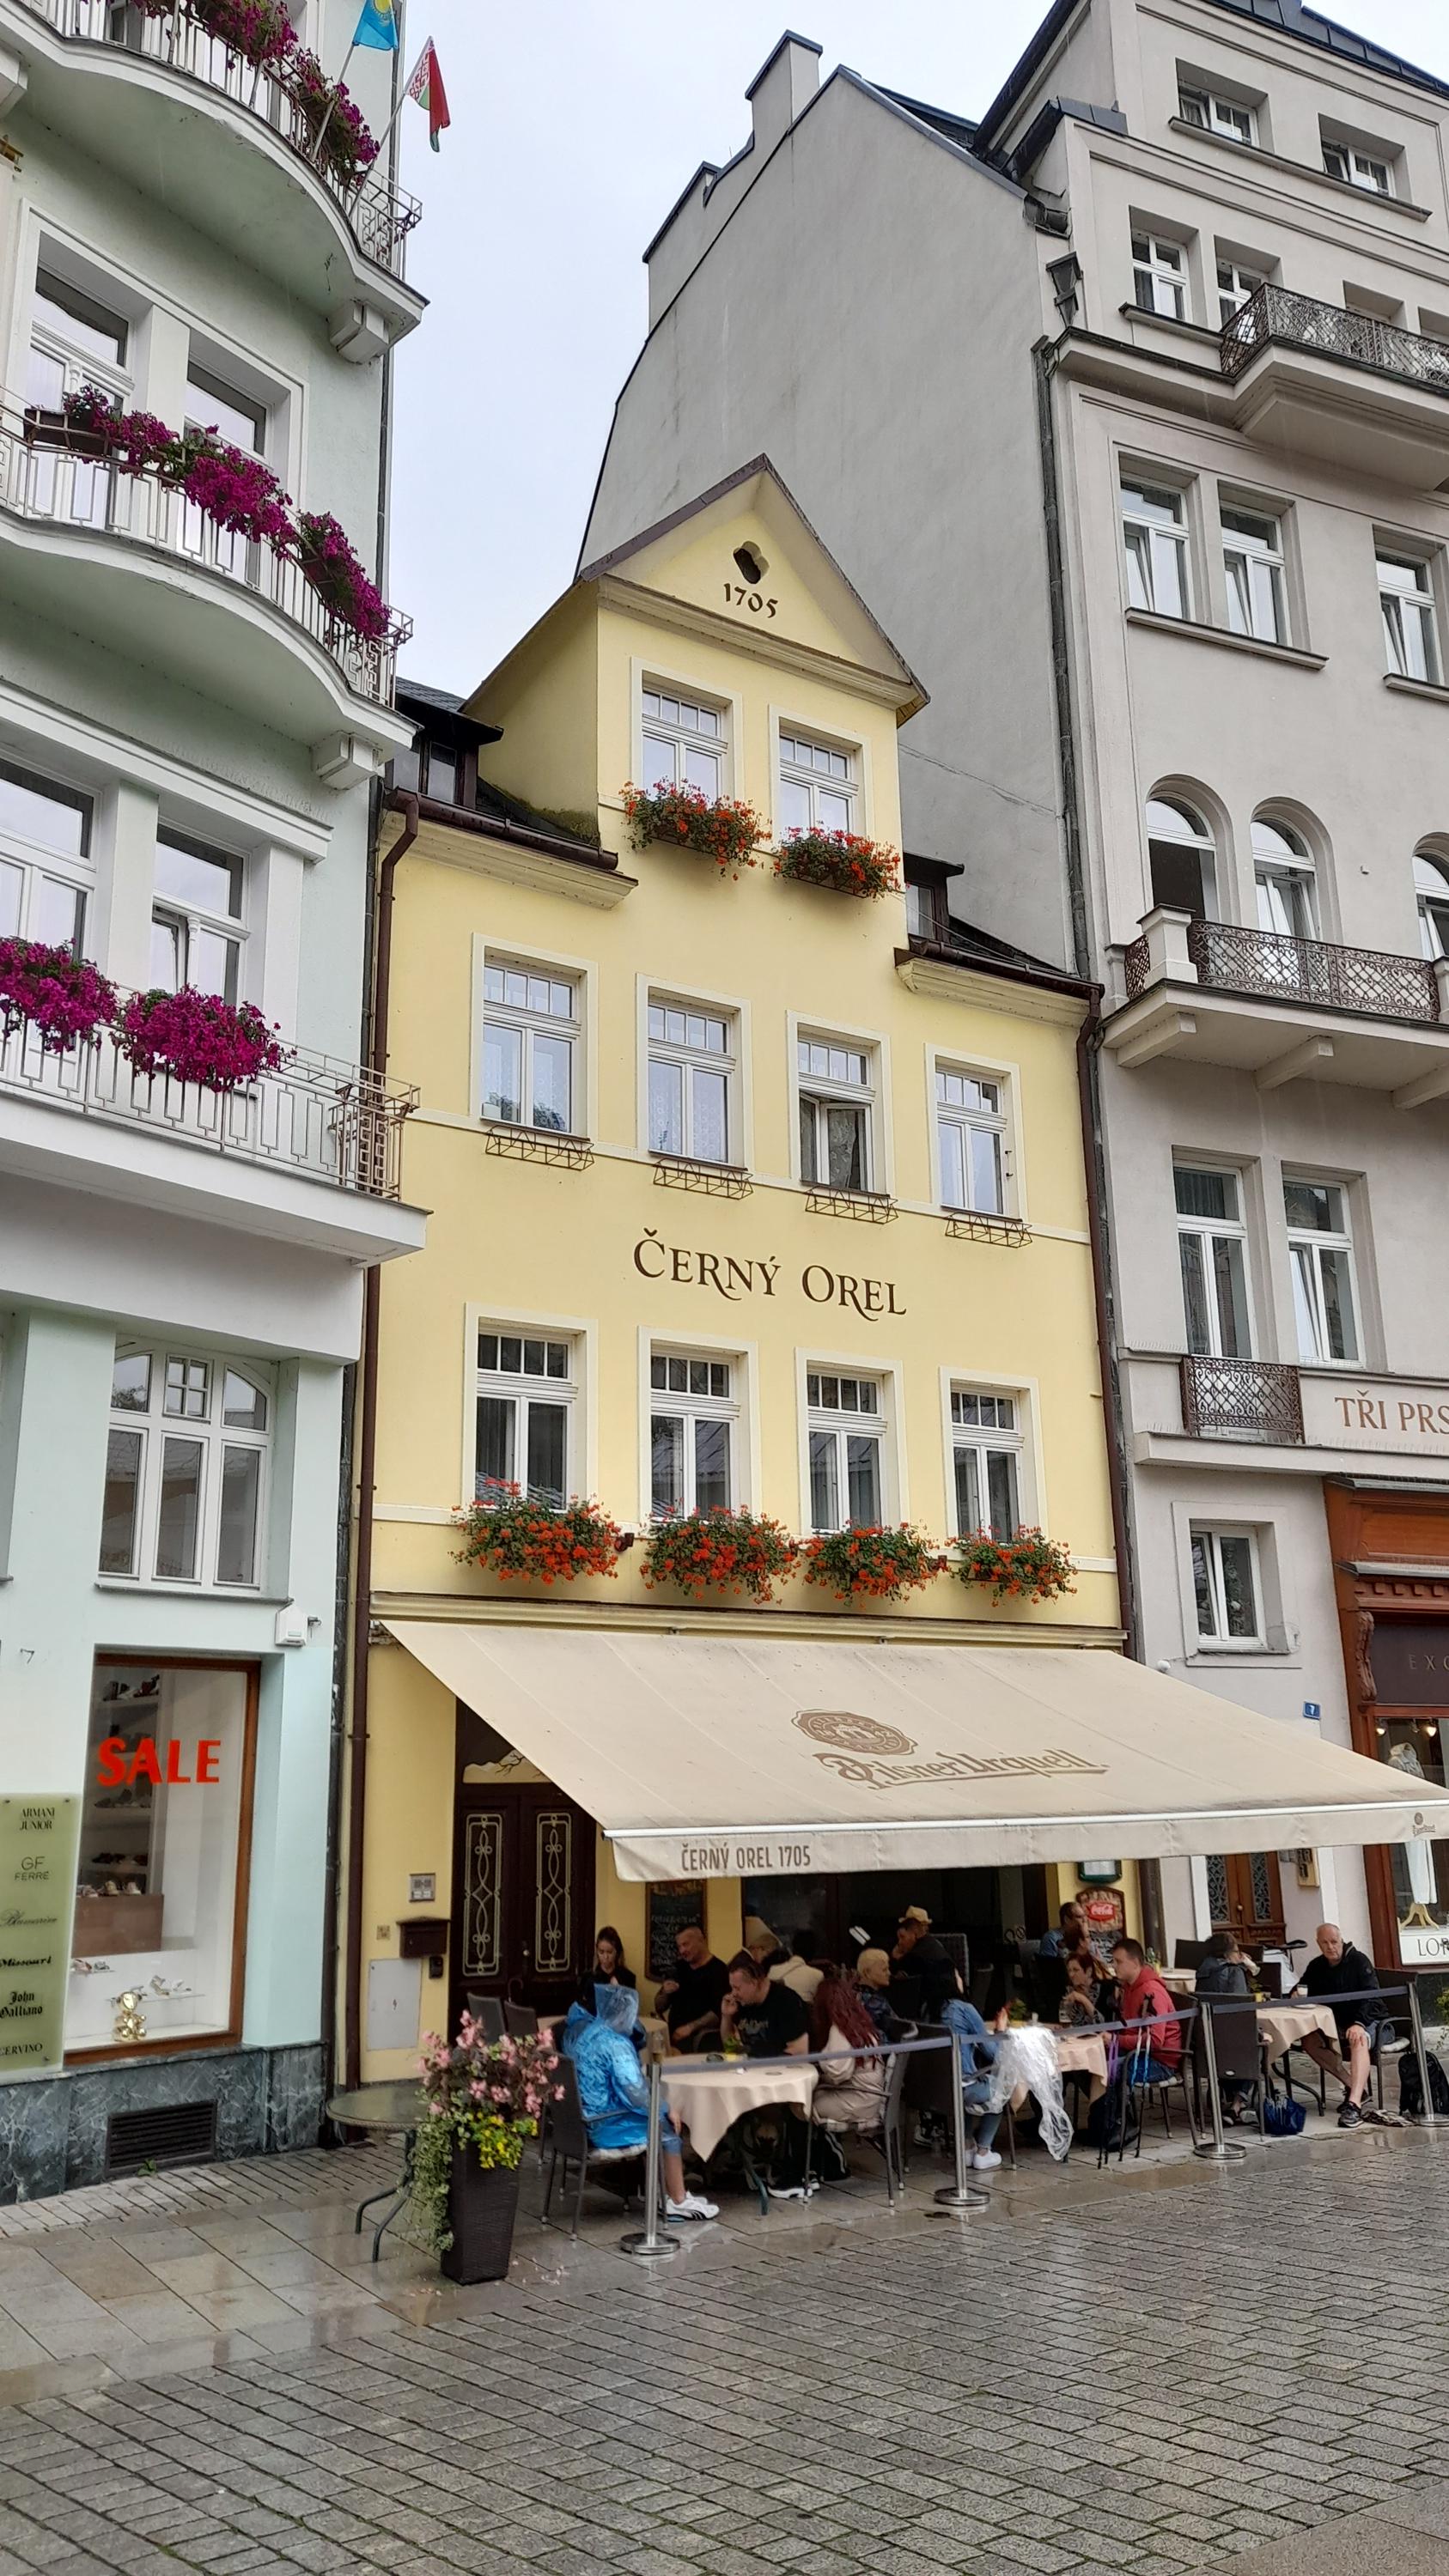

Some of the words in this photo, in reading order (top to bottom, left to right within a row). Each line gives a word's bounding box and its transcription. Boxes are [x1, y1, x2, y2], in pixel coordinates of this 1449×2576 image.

[723, 583, 778, 618] 1705
[634, 1227, 782, 1301] ČERNÝ
[801, 1265, 907, 1321] OREL
[1335, 1389, 1387, 1430] TŘI
[97, 1736, 221, 1787] SALE
[813, 1753, 967, 1789] Pilsner
[20, 1820, 53, 1831] JUNIOR
[21, 1807, 55, 1818] ARMANI
[21, 1856, 46, 1871] GF
[681, 1842, 729, 1871] ČERNÝ
[736, 1846, 772, 1869] OREL
[778, 1845, 811, 1868] 1705
[9, 1990, 35, 2005] John
